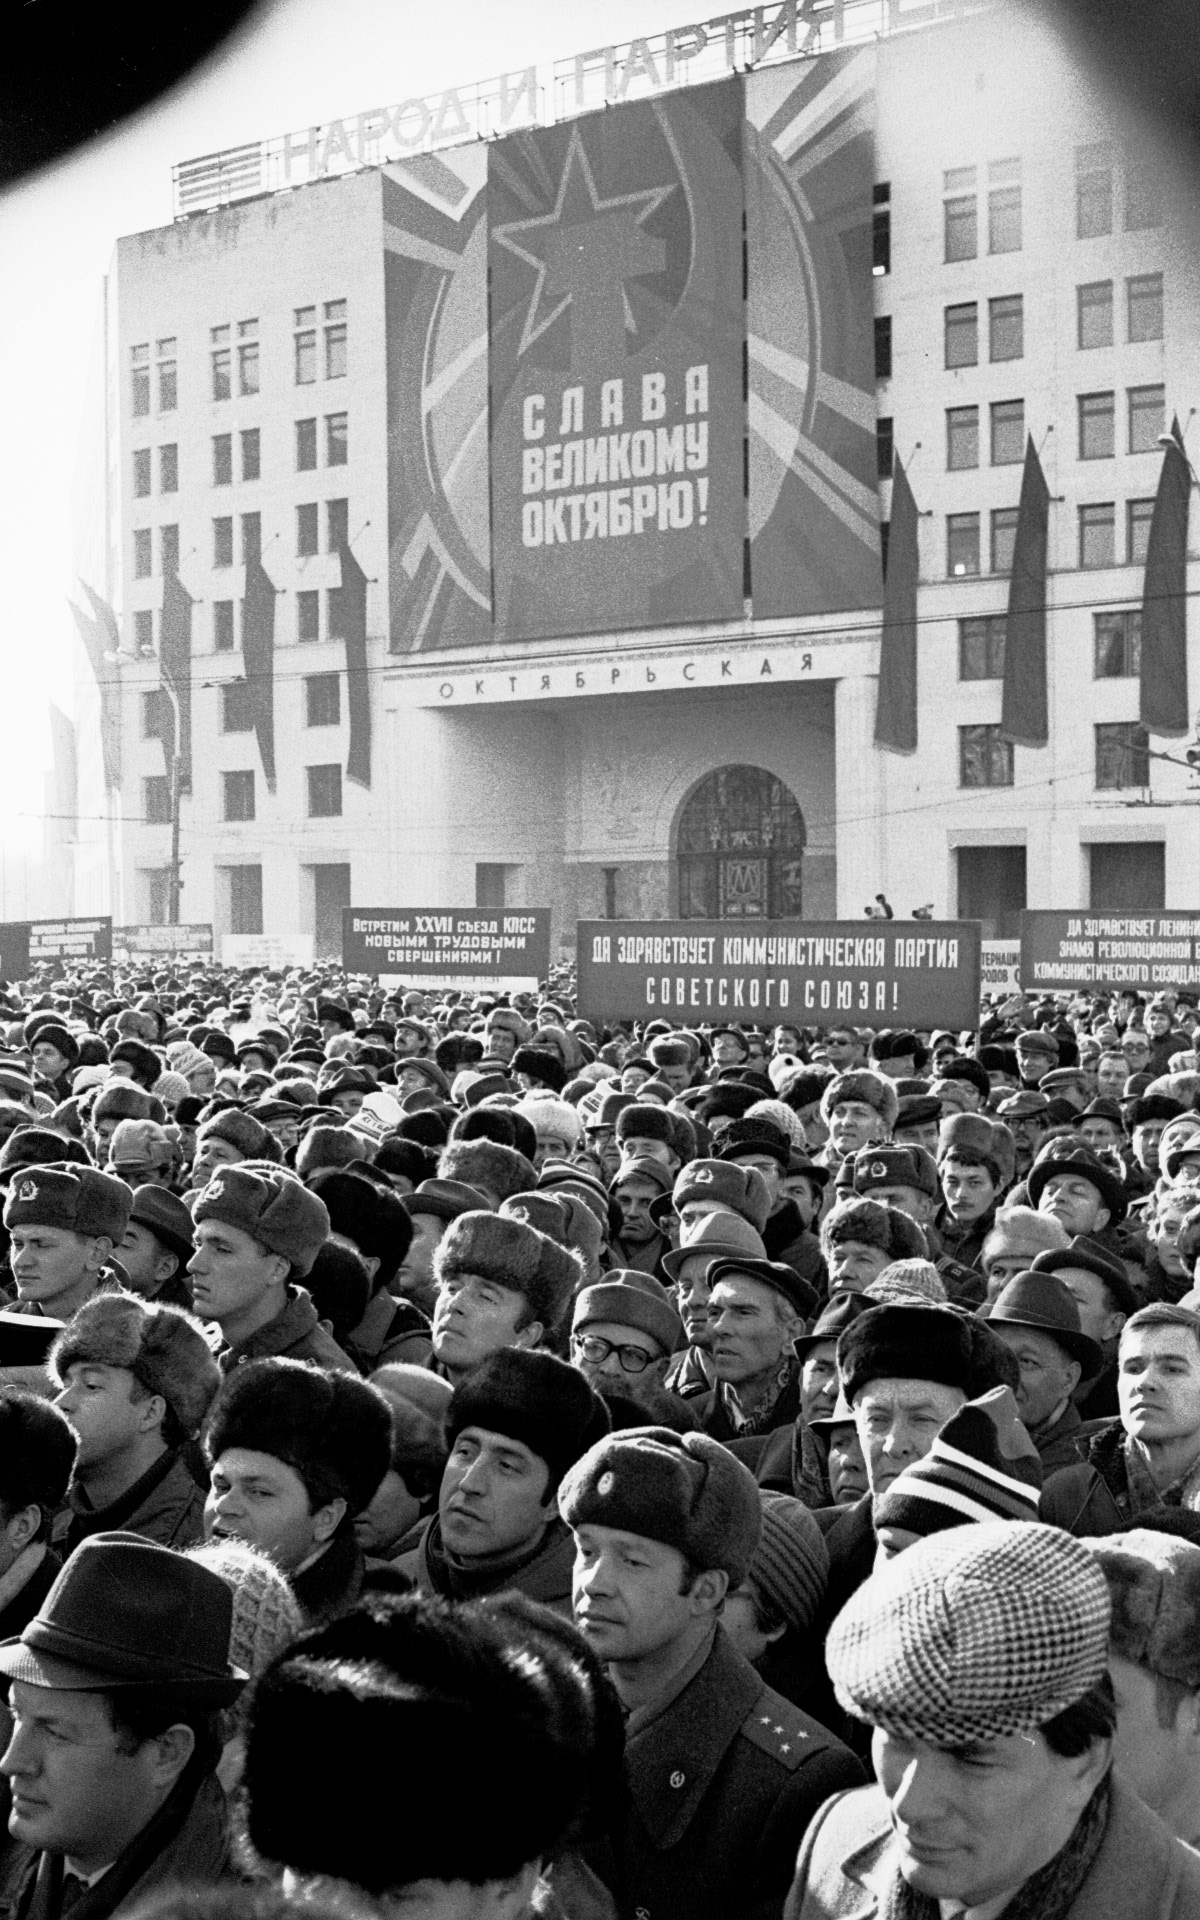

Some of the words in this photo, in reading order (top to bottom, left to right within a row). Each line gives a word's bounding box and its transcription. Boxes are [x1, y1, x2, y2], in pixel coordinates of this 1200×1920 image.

[284, 88, 471, 179] НАРОД
[500, 66, 538, 126] И
[574, 0, 844, 106] ПАРТИЯ
[523, 364, 709, 440] СЛАВА
[522, 421, 709, 495] ВЕЛИКОМУ
[522, 477, 709, 547] ОКТЯБРЮ!
[439, 653, 812, 699] ОКТЯБРЬСКАЯ
[365, 934, 427, 948] НОВЫМИ
[434, 935, 526, 949] ТРУДОВЫМИ
[503, 917, 536, 934] КПСС
[1067, 919, 1082, 937] ДА
[1085, 918, 1156, 937] ЗДРАВСТВУЕТ
[593, 936, 611, 963] ДА
[618, 936, 715, 964] ЗДРАВСТВУЕТ
[723, 937, 885, 967] КОММУНИСТИЧЕСКАЯ
[895, 938, 958, 968] ПАРТИЯ
[1059, 940, 1094, 958] ЗНАМЯ
[1098, 939, 1192, 961] РЕВОЛЮЦИОННОЙ
[1034, 962, 1149, 982] КОММУНИСТИЧЕСКОГО
[646, 977, 789, 1007] СОВЕТСКОГО
[805, 980, 898, 1011] СОЮЗА!
